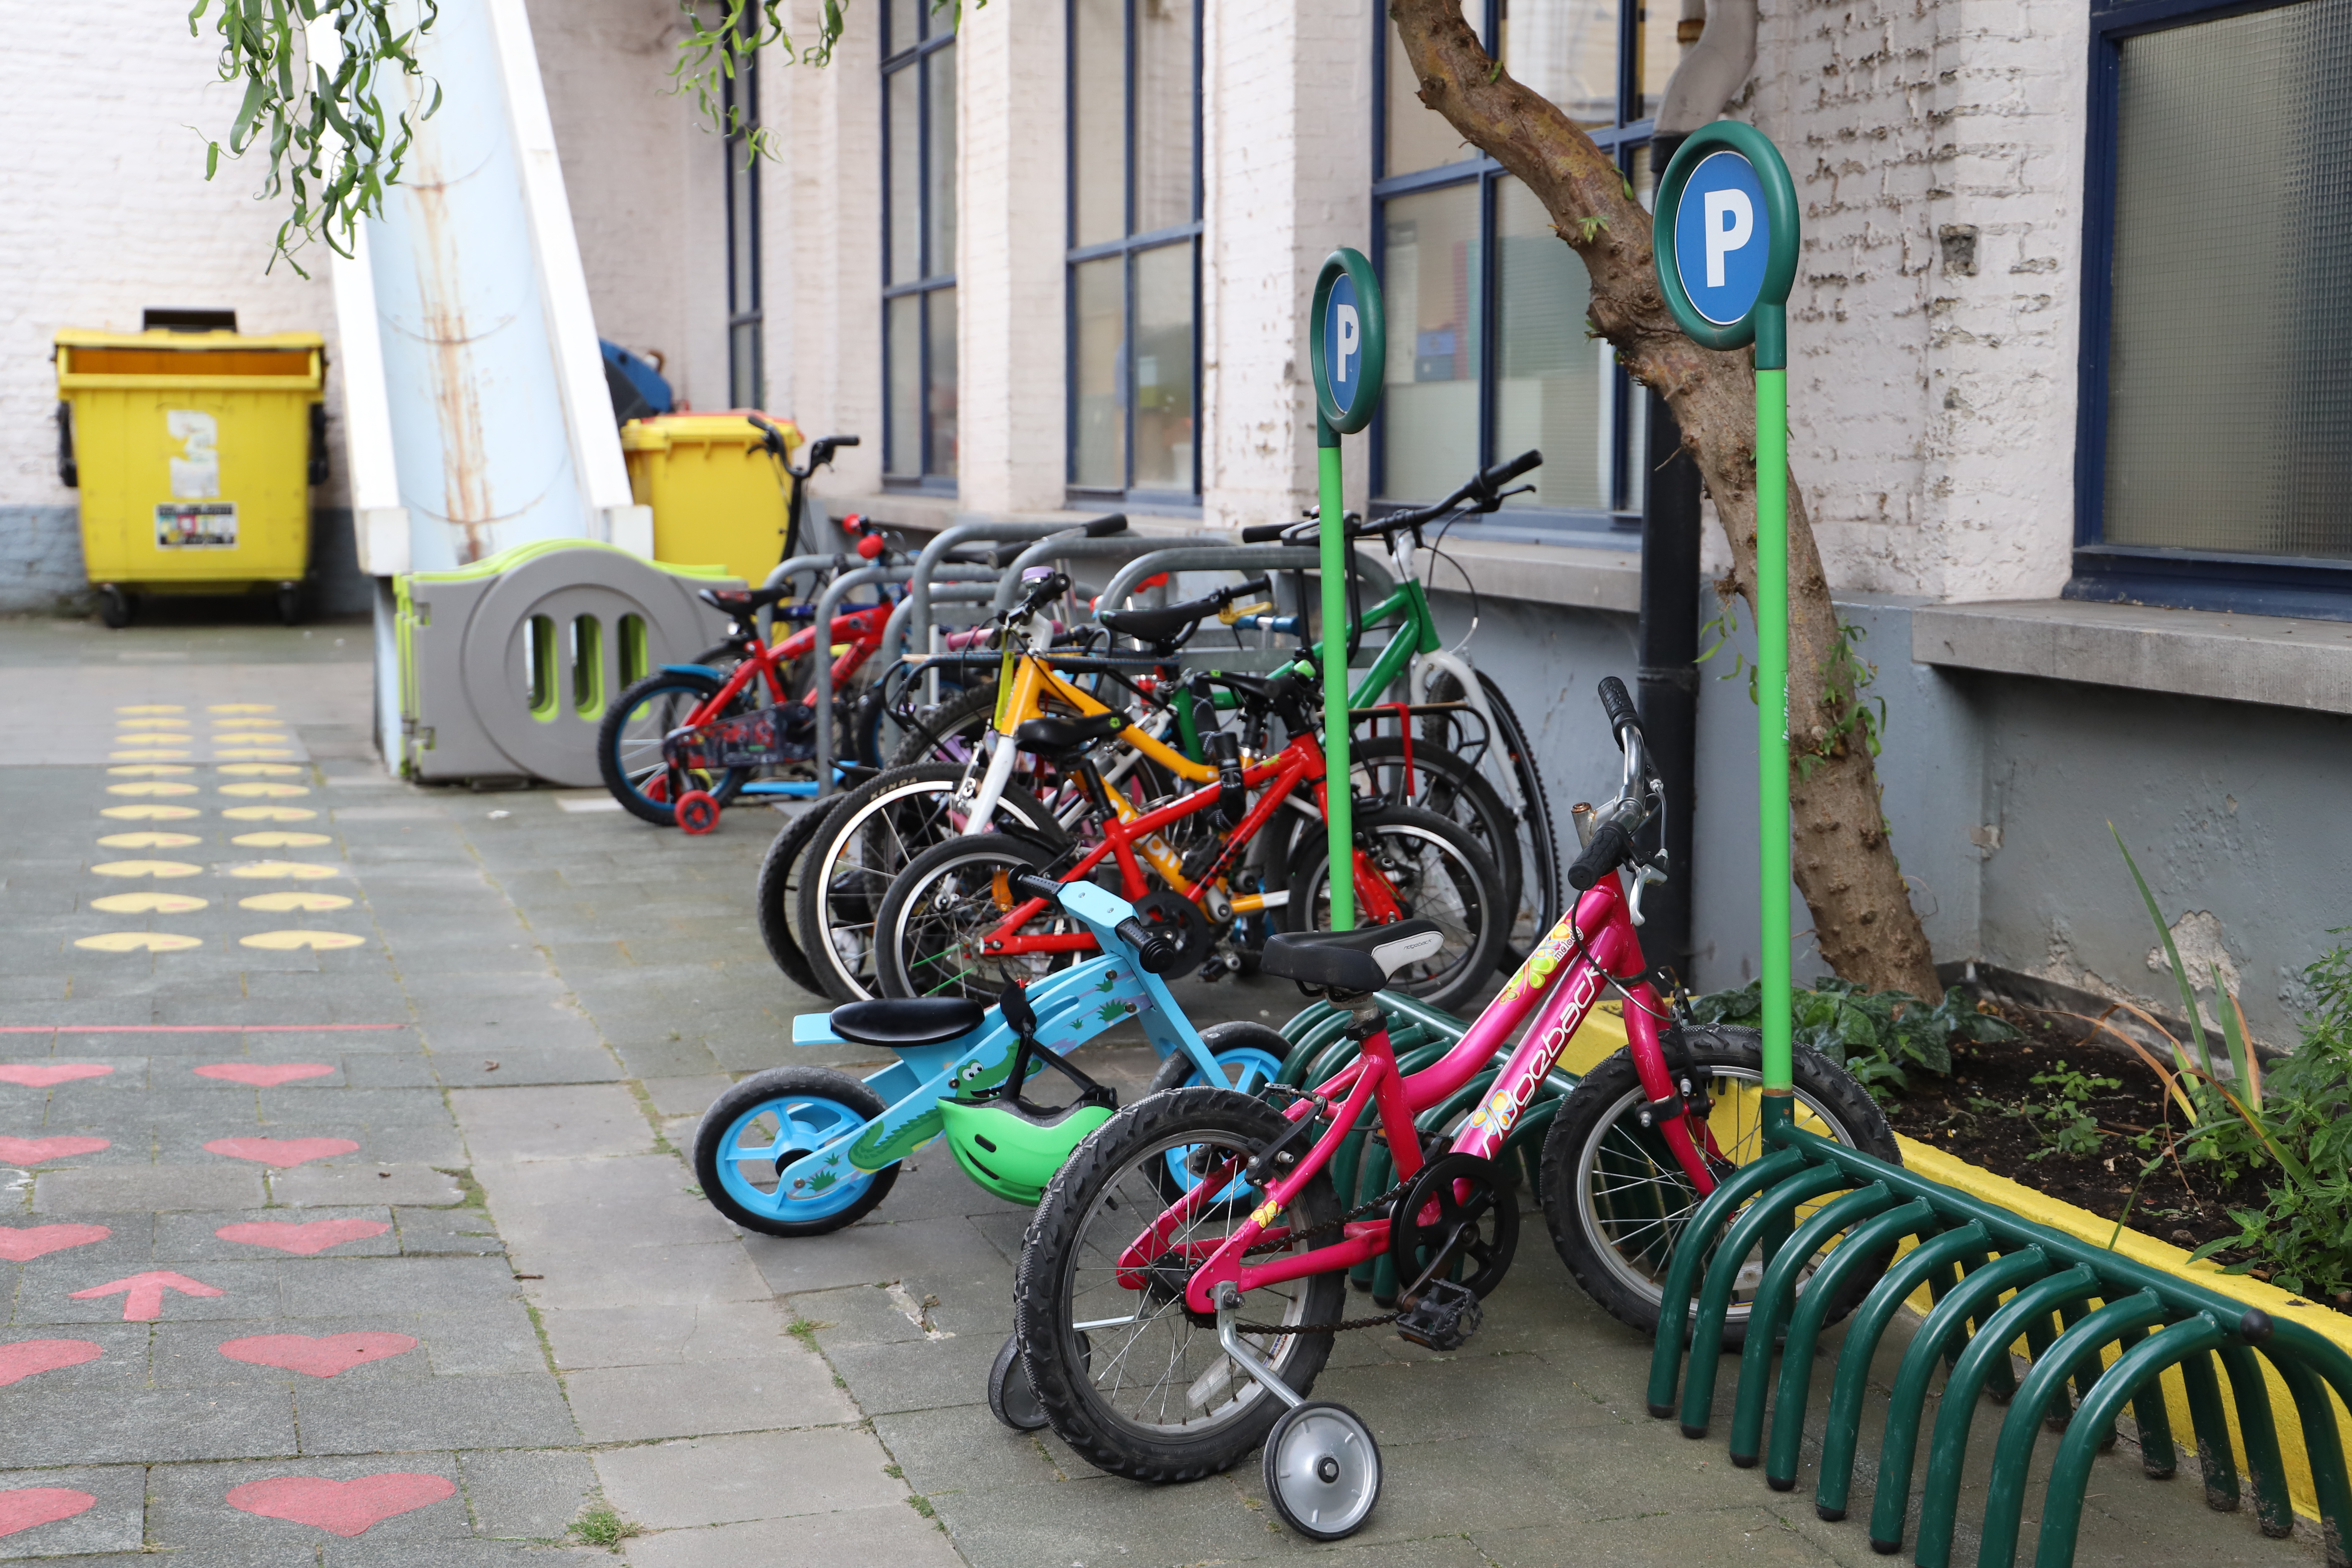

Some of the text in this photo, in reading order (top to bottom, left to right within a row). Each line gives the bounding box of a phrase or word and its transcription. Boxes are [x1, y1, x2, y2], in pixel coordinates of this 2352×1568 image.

[1705, 188, 1753, 287] P
[1337, 304, 1359, 382] P
[870, 776, 918, 801] KENDA
[1403, 939, 1432, 950] ridgeback
[1554, 927, 1583, 961] melody
[1482, 955, 1608, 1161] ridgeback
